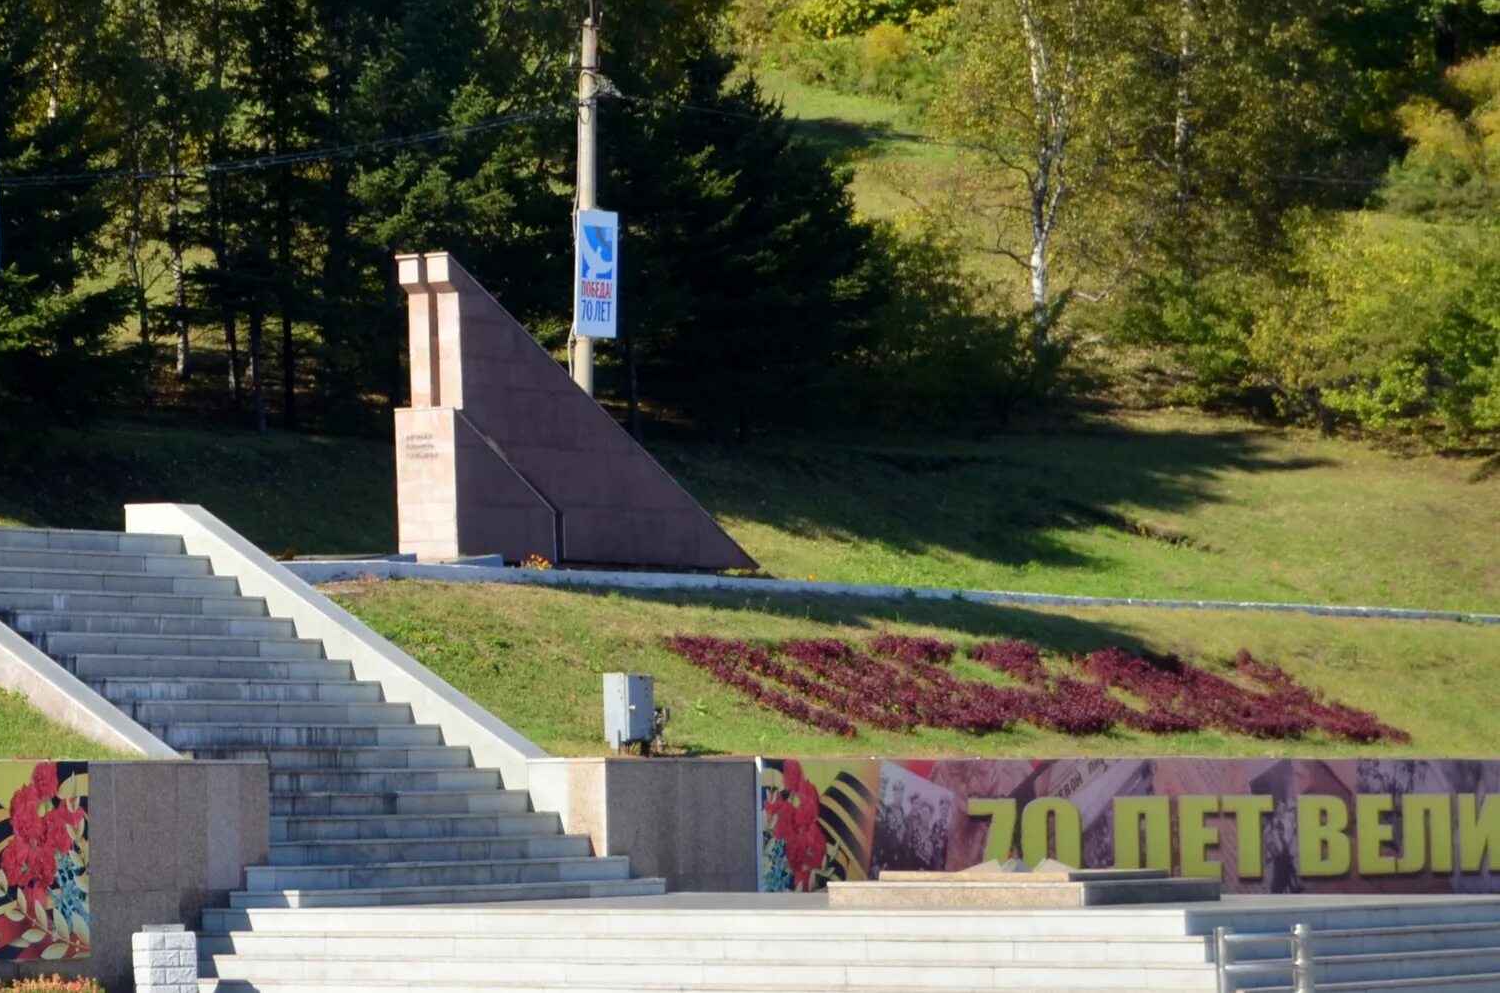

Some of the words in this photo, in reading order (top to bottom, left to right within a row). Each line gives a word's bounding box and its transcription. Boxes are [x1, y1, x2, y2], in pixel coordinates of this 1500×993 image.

[581, 280, 612, 299] ПОБЕДА!
[581, 299, 593, 321] 70
[593, 300, 612, 322] ЛЕТ
[967, 796, 1080, 870] 70
[1106, 794, 1274, 878] ЛЕТ
